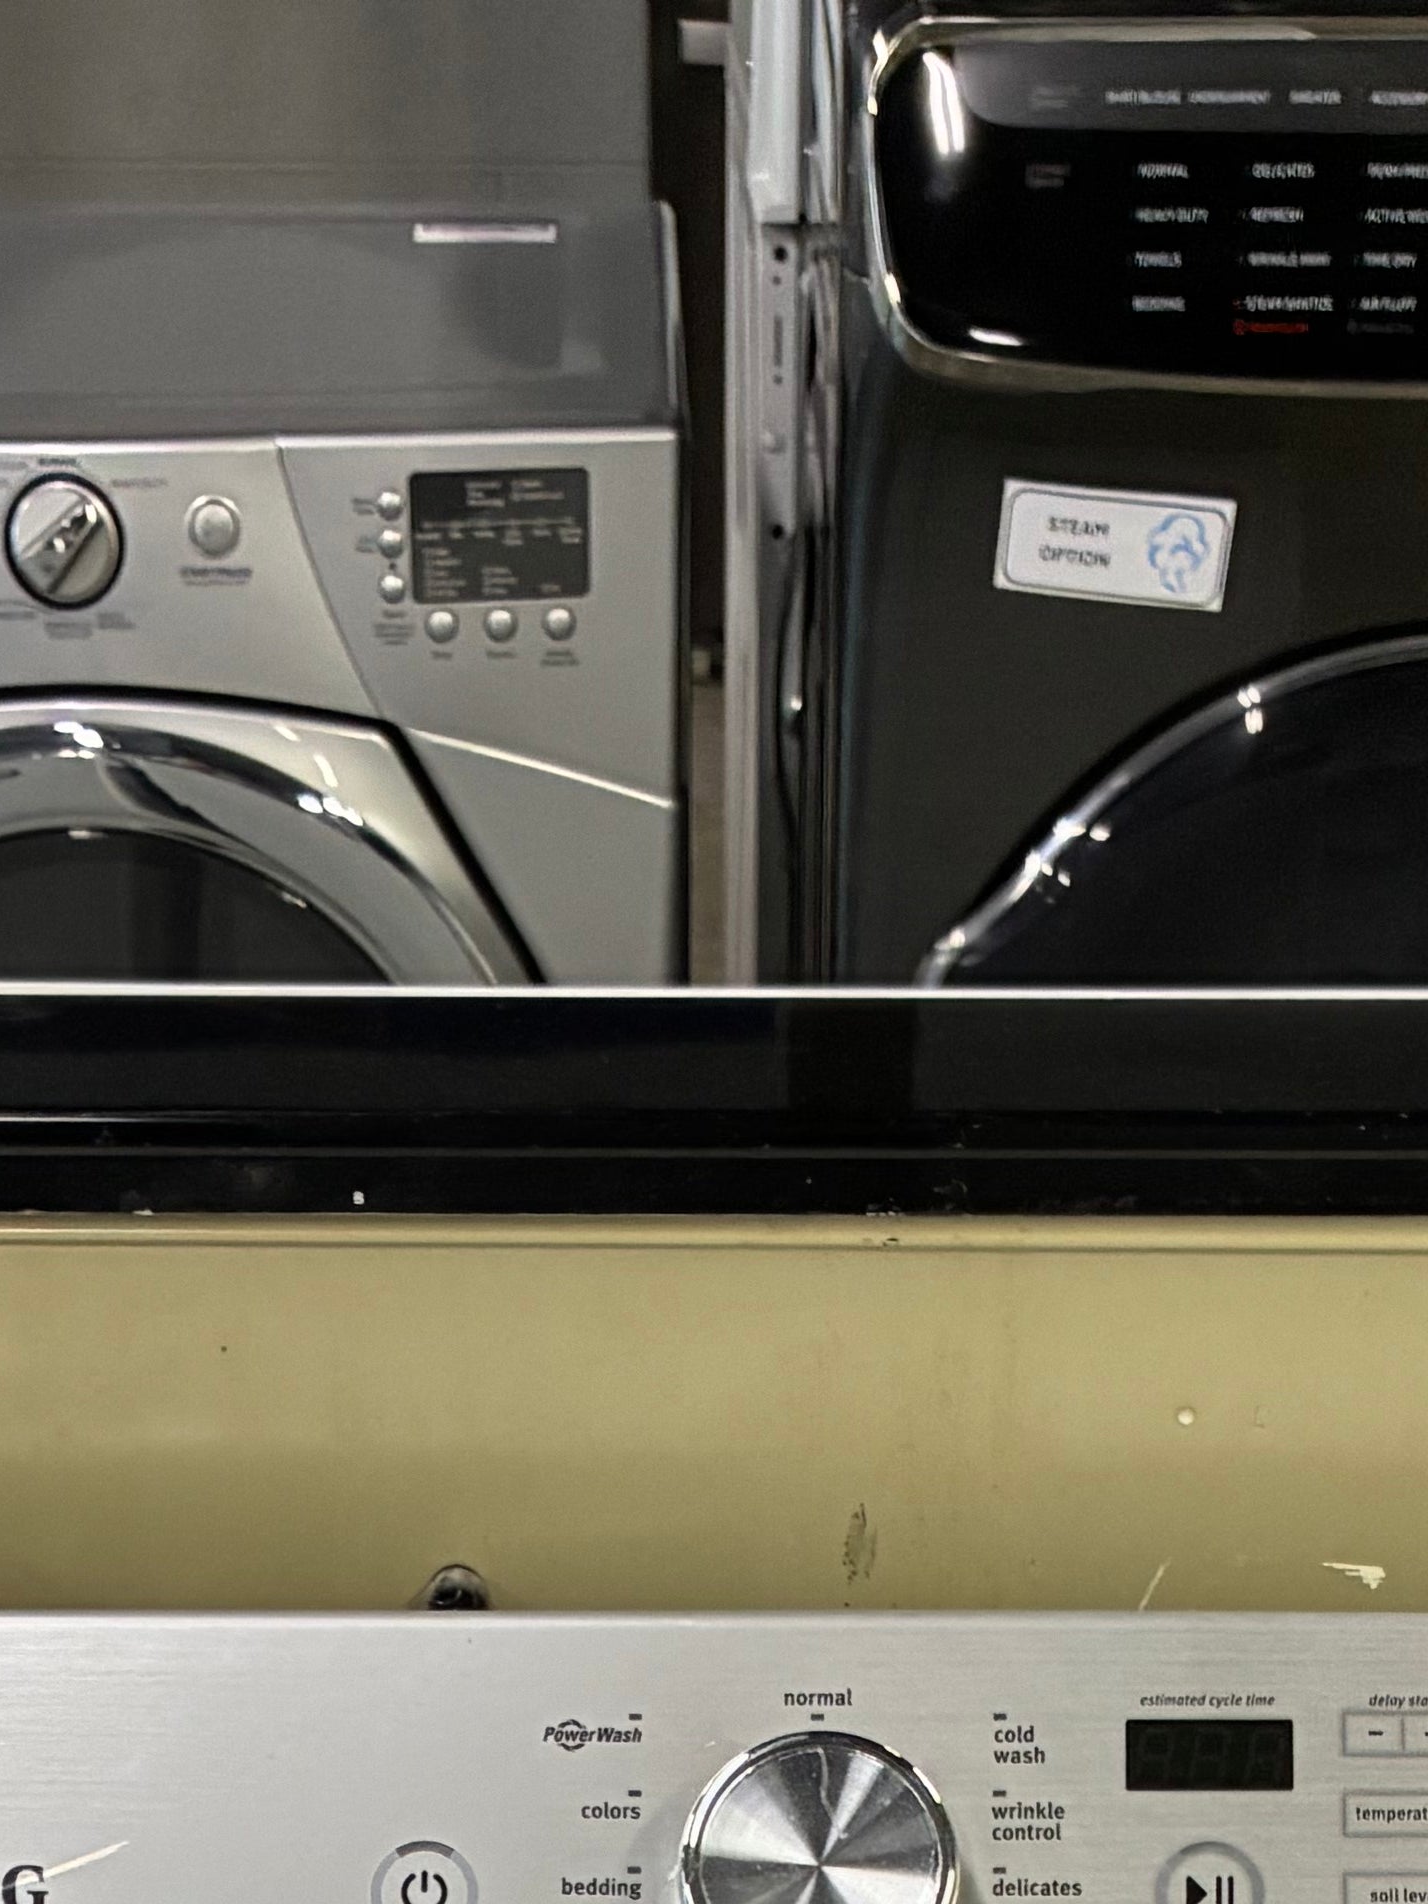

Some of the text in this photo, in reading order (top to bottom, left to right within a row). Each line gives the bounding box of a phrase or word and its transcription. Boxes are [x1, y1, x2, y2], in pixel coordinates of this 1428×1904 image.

[1047, 515, 1111, 536] STEAM
[1038, 543, 1111, 569] OPTION
[783, 1687, 853, 1707] normal
[1139, 1692, 1275, 1709] estimated cycle time
[1369, 1694, 1407, 1709] delay
[992, 1724, 1035, 1745] cold
[992, 1745, 1045, 1766] wash
[580, 1801, 642, 1821] colors
[992, 1801, 1065, 1821] wrinkle
[991, 1822, 1062, 1842] control
[561, 1877, 642, 1900] bedding
[992, 1878, 1083, 1899] delicates
